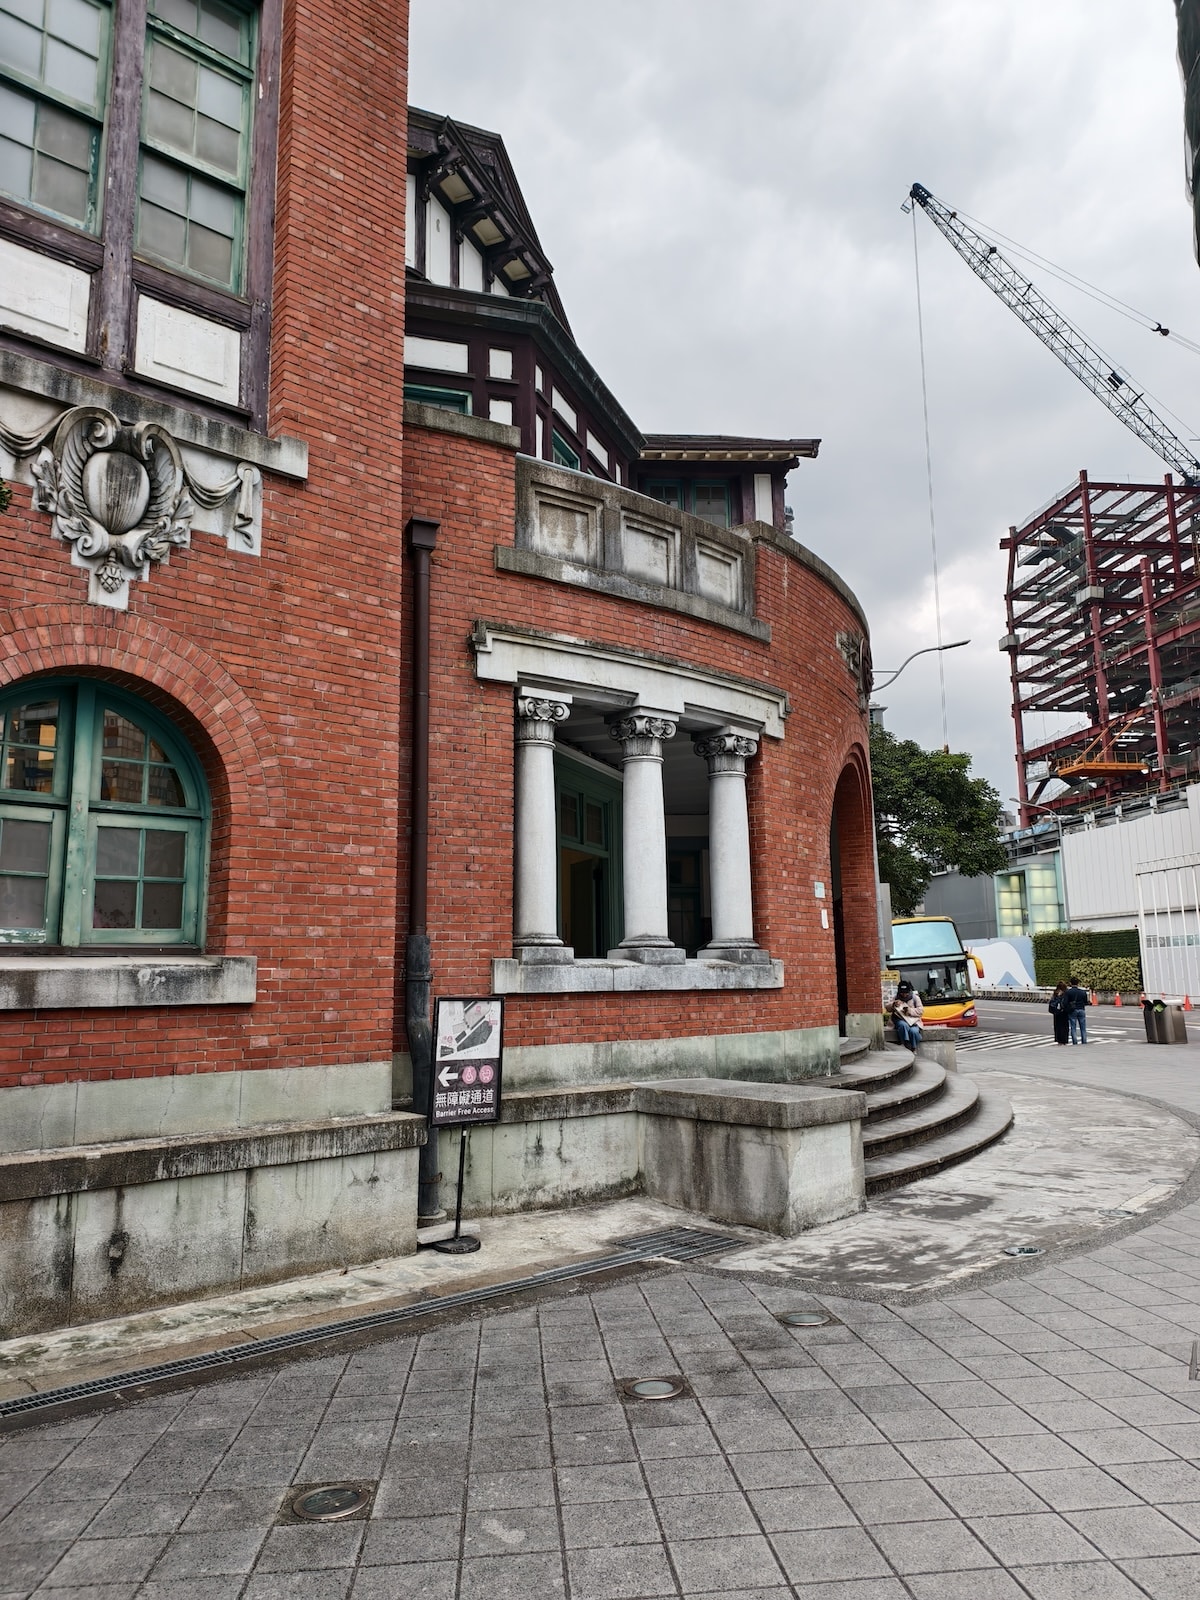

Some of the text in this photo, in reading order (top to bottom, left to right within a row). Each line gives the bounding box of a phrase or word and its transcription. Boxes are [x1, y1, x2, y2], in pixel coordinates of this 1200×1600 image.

[435, 1088, 494, 1108] 無障礙通道
[435, 1109, 456, 1118] Barrier
[457, 1108, 471, 1116] Free
